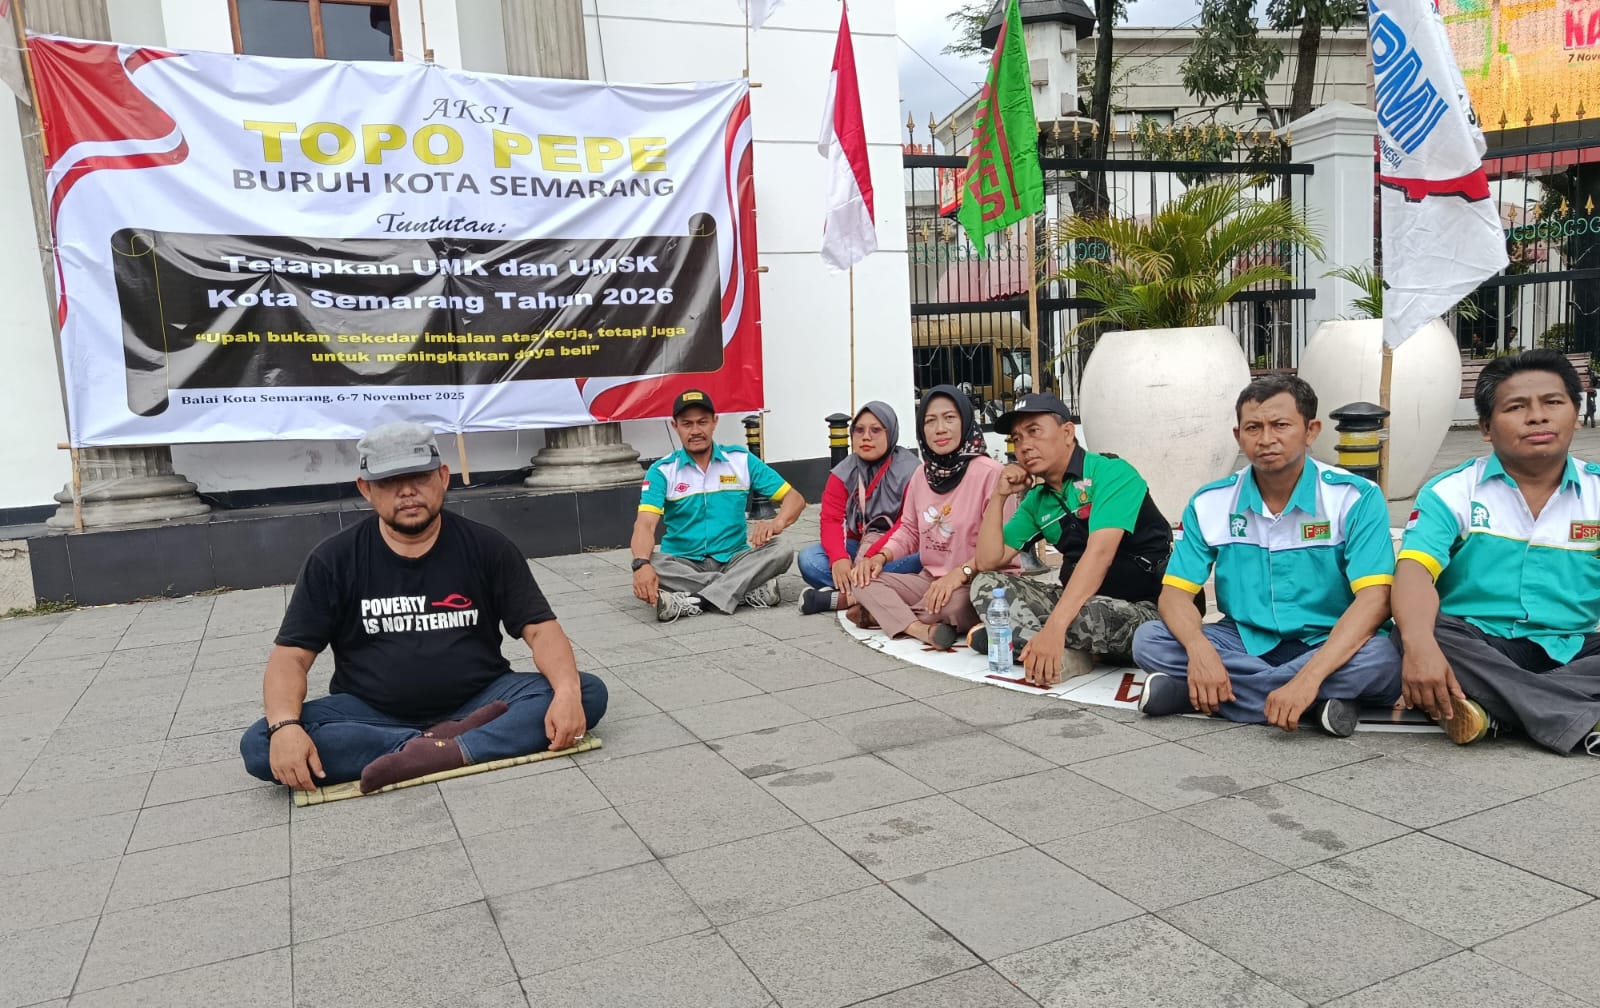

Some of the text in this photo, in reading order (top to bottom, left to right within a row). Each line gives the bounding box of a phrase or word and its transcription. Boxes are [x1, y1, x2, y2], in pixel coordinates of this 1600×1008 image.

[1568, 53, 1575, 63] 7
[423, 98, 513, 125] AKSI
[243, 119, 667, 173] TOPO PEPE
[232, 169, 674, 198] BURUH KOTA SEMARANG
[377, 212, 507, 233] Tuntutan:
[220, 255, 659, 278] Tetapkan UMK dan UMSK
[207, 287, 674, 314] Kota Semarang Tahun 2026
[267, 331, 331, 343] bukan
[337, 331, 419, 344] sekedar
[424, 331, 496, 344] imbalan
[501, 331, 539, 343] atas
[598, 327, 647, 340] tetapi
[651, 325, 687, 338] juga
[311, 351, 370, 362] untuk
[376, 350, 510, 364] meningkatkan
[514, 347, 555, 360] daya
[181, 391, 465, 405] Balai Kota Semarang, 6-7 November 2025
[361, 595, 426, 617] POVERTY
[362, 609, 479, 634] IS NOT ETERNITY
